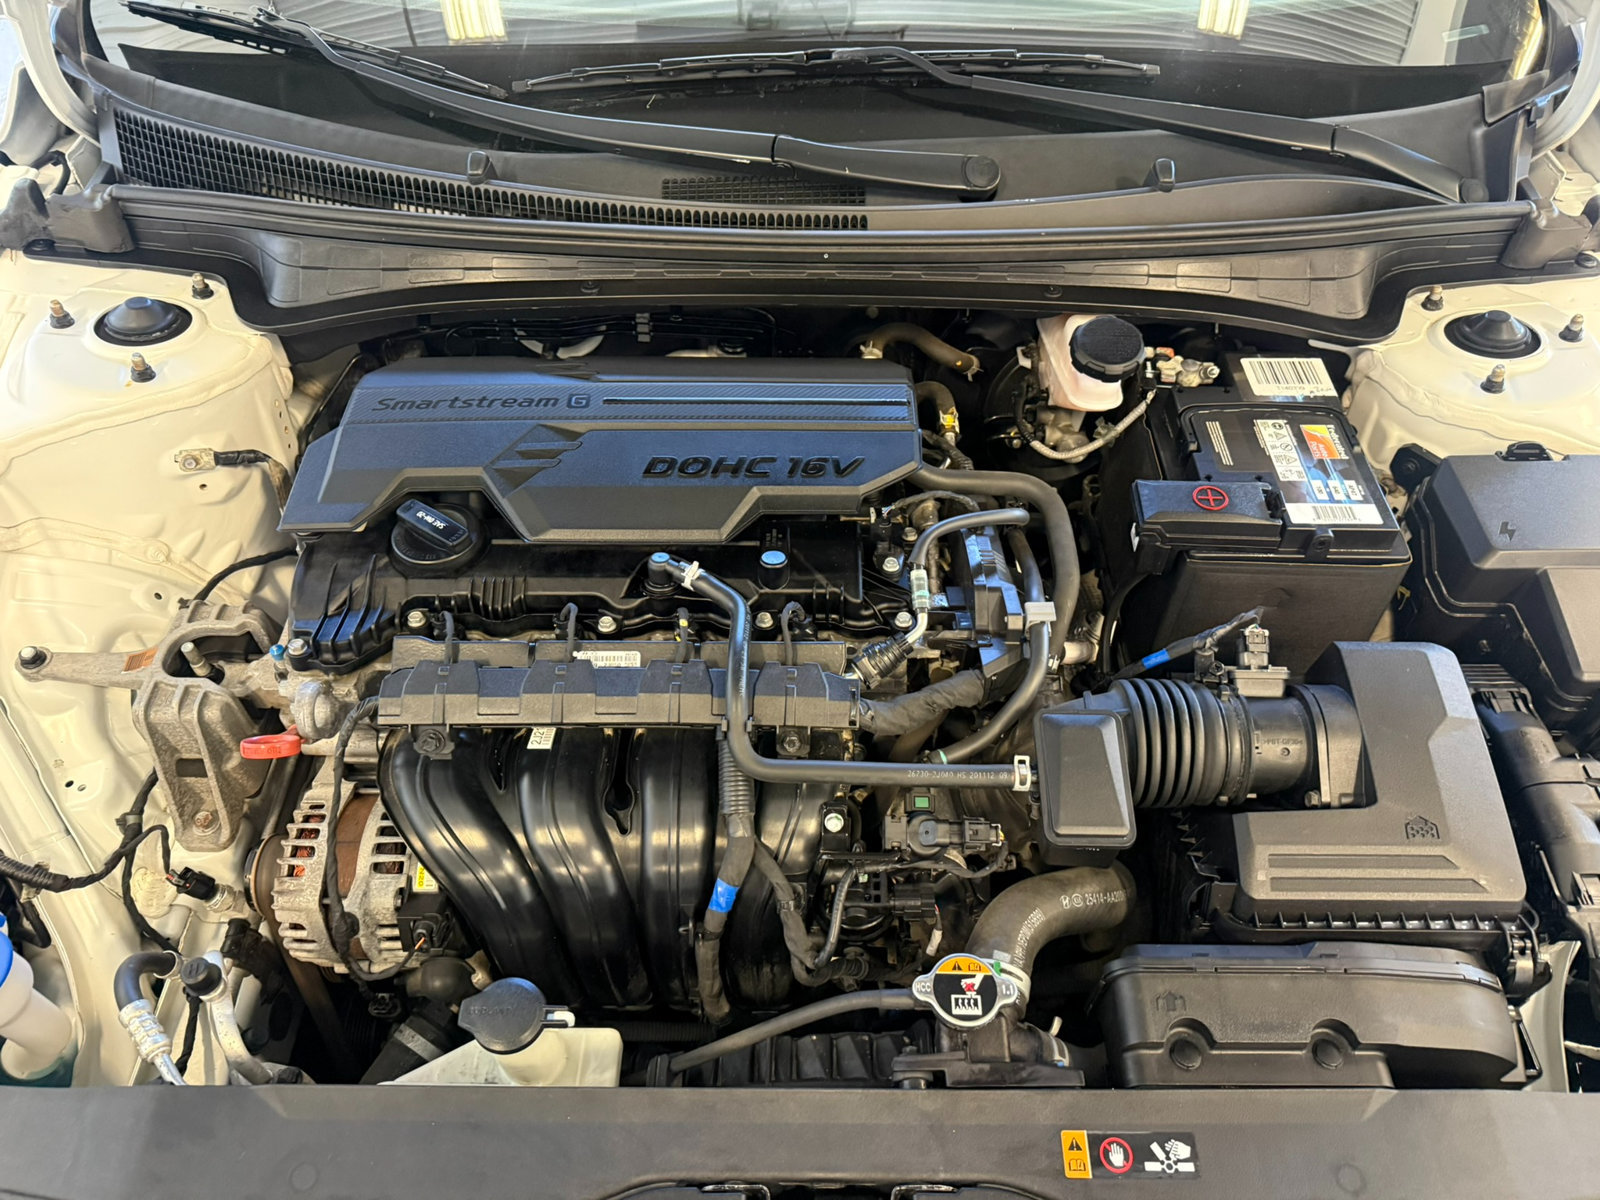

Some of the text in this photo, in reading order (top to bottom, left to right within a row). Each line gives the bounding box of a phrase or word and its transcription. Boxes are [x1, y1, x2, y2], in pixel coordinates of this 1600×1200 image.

[371, 396, 560, 412] Smartstream
[641, 455, 865, 479] DOHC 16V
[915, 981, 932, 993] HCC
